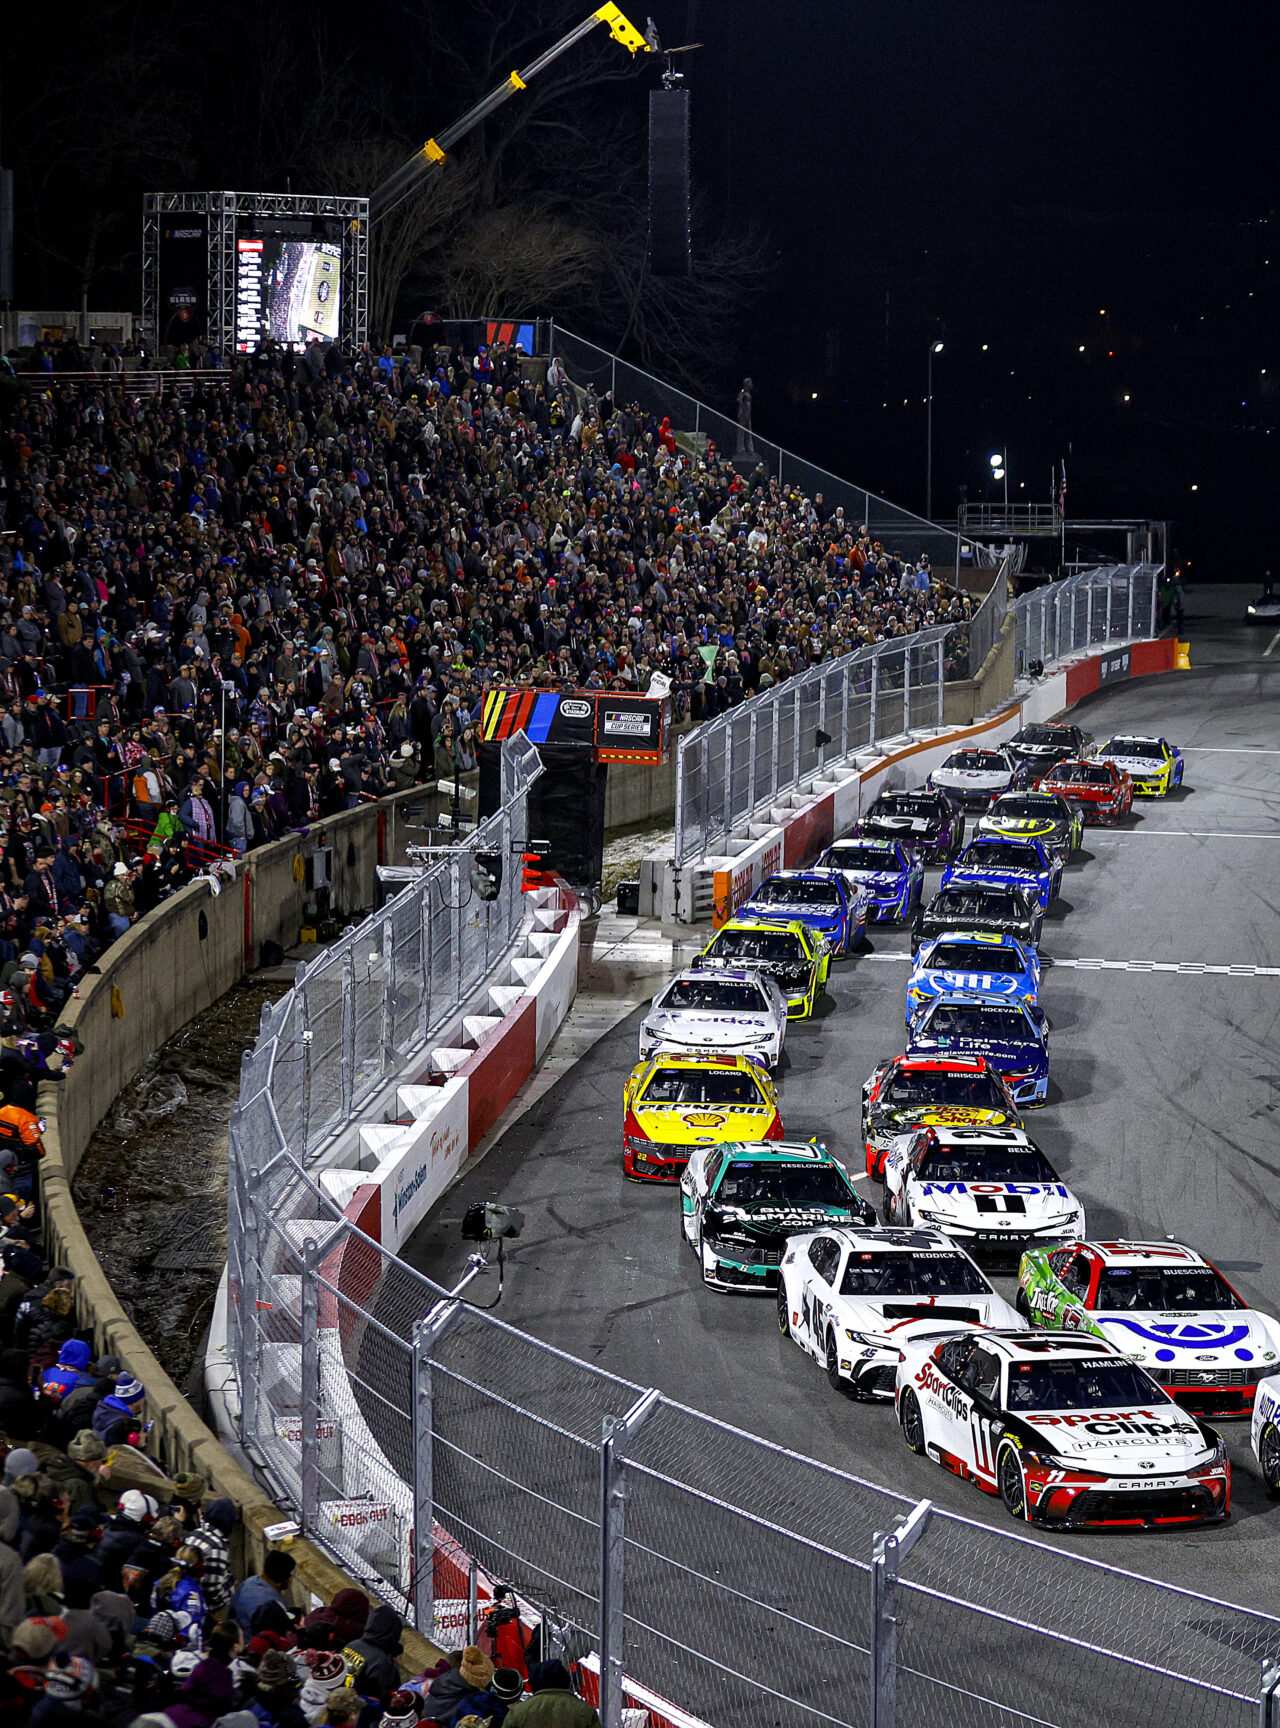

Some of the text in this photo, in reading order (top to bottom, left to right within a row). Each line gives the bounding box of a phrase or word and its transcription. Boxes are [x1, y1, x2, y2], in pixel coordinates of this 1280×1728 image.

[619, 714, 645, 722] NASCAR
[624, 723, 644, 731] SERIES
[960, 1037, 1040, 1048] Delaware
[637, 1103, 769, 1116] PENNZOIL
[936, 1116, 992, 1126] Shops
[637, 1153, 647, 1161] 22
[922, 1182, 1069, 1198] Mobil
[988, 1196, 1007, 1212] 1
[722, 1213, 866, 1225] SUBMARINES
[861, 1348, 878, 1358] 45
[1082, 1361, 1128, 1369] HAMLIN
[928, 1396, 953, 1421] HAIRCUTS
[1259, 1392, 1276, 1422] AUTO
[1025, 1410, 1161, 1426] Sport
[1085, 1421, 1199, 1437] Clips
[971, 1411, 996, 1477] 11
[1078, 1437, 1187, 1450] HAIRCUTS
[1047, 1470, 1066, 1482] 11
[1118, 1480, 1180, 1489] CAMRY
